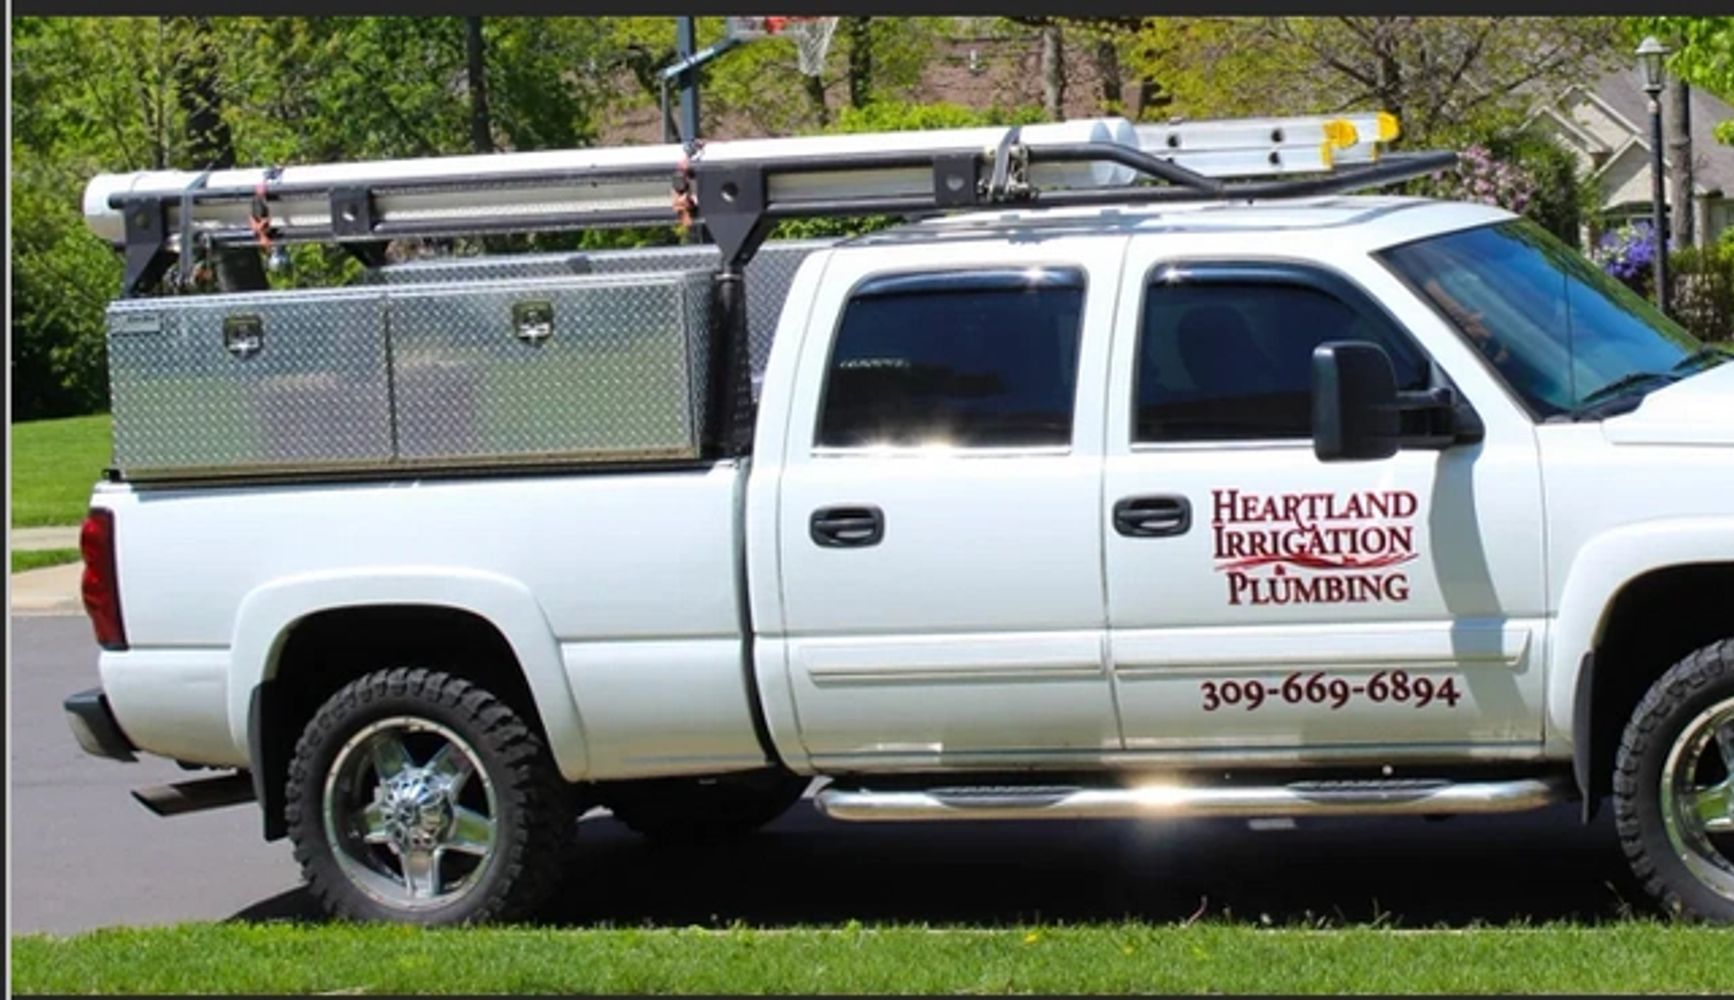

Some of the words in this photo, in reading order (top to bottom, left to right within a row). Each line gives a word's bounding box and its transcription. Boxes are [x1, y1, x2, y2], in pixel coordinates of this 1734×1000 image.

[1211, 489, 1418, 532] HEARTLAND
[1212, 524, 1413, 559] IRRIGATION
[1226, 571, 1410, 605] PLUMBING
[1201, 669, 1461, 711] 309-669-6894
